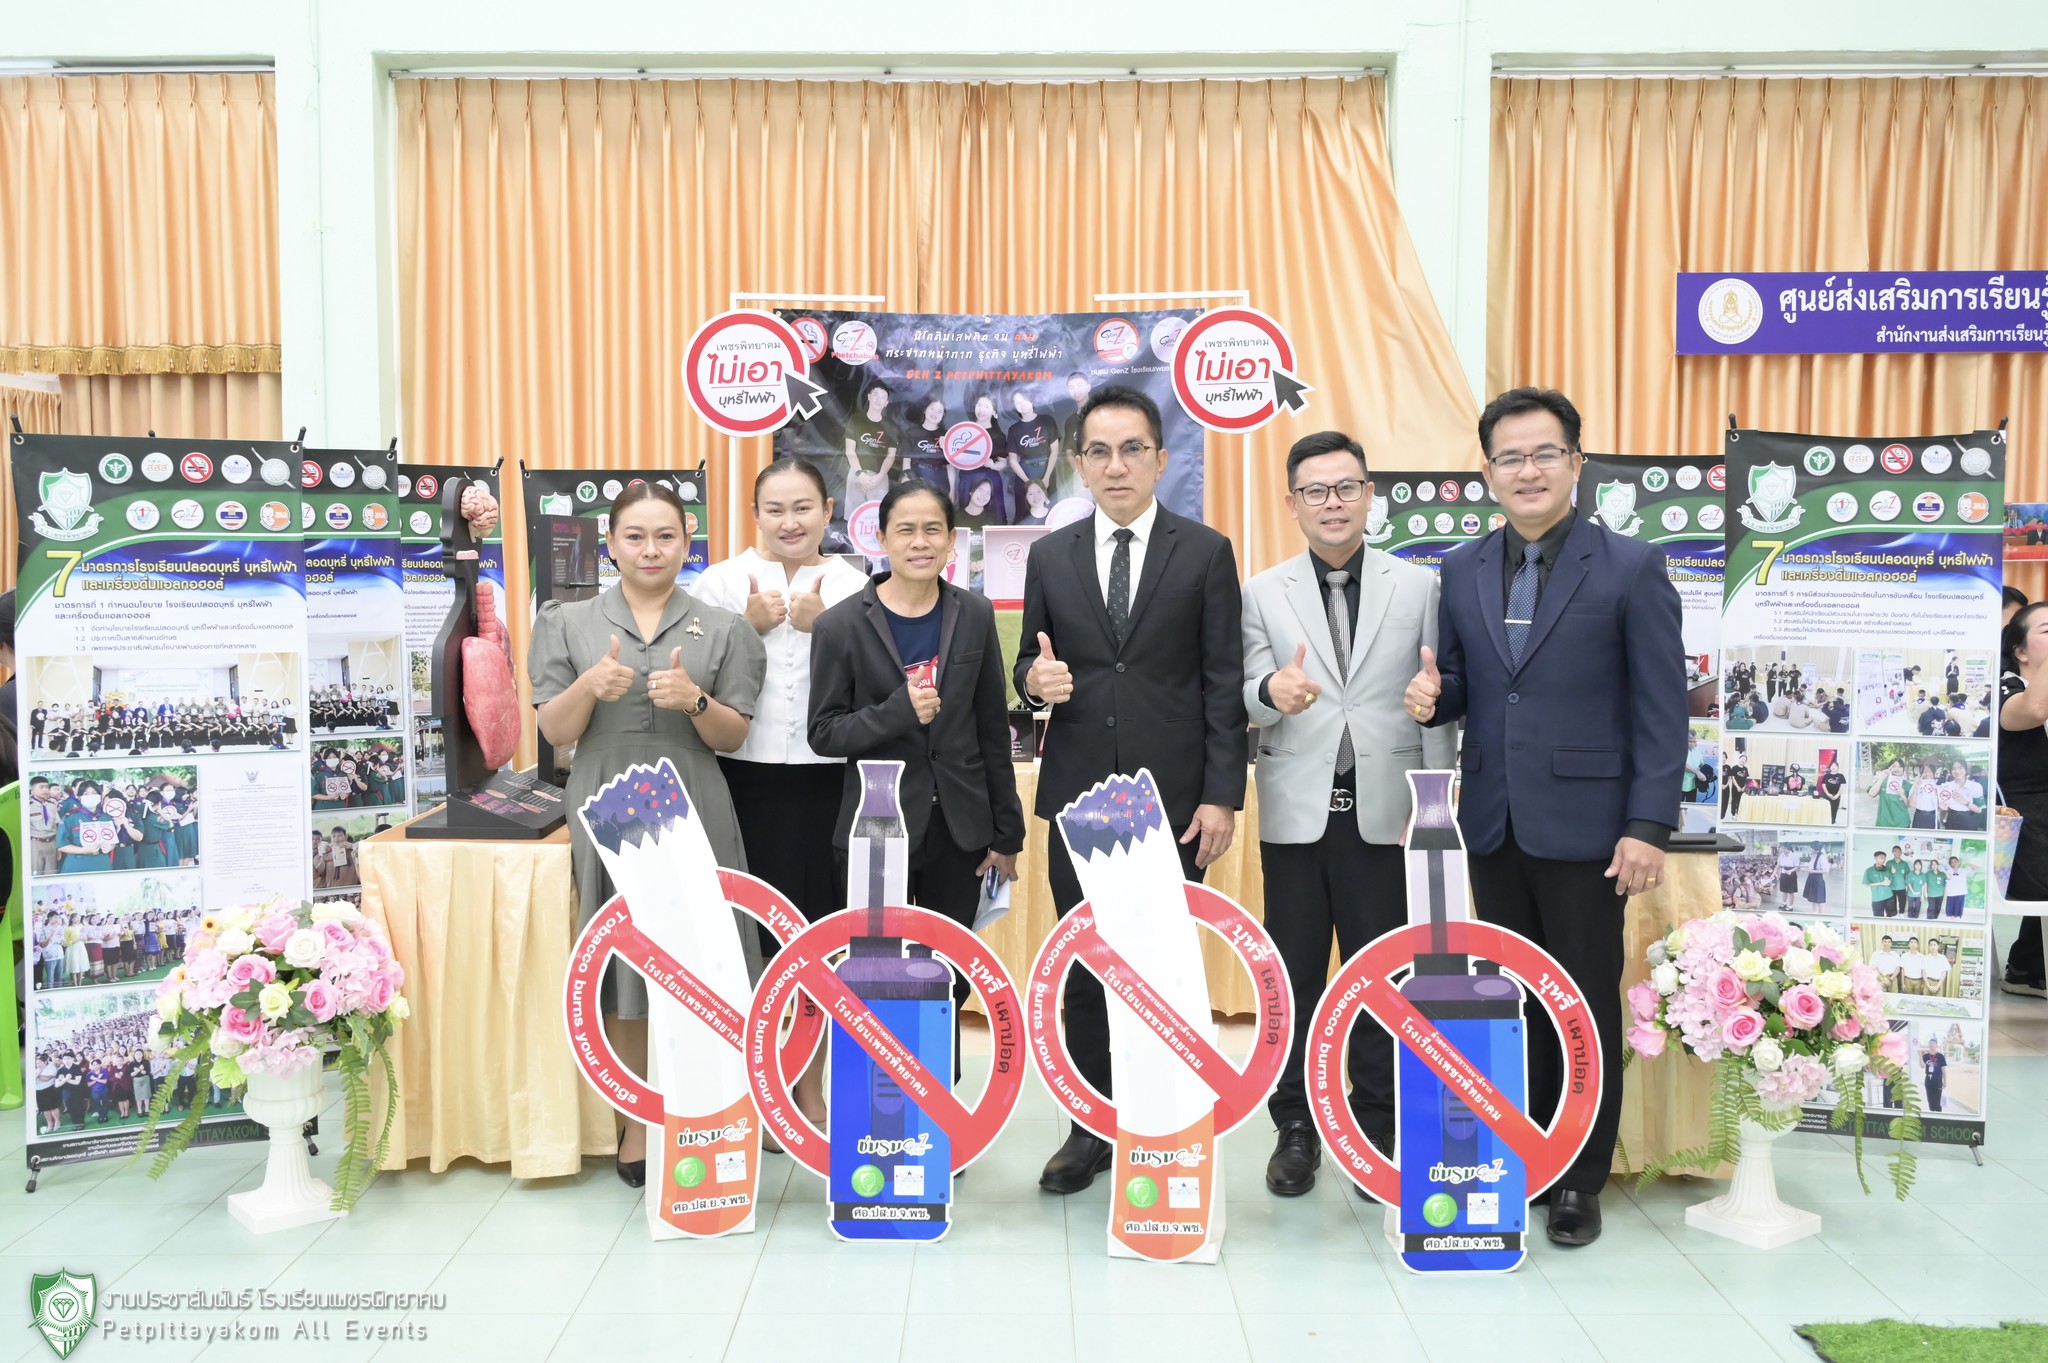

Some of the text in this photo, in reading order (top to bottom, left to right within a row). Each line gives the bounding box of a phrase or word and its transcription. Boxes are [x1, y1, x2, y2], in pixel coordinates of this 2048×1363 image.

[1779, 275, 2047, 323] ศูนย์ส่งเสริมการเรียน
[716, 340, 781, 351] เพชรพิทยาคม
[1204, 337, 1270, 348] เพชรพิทยาคม
[831, 351, 880, 360] Phetchabun
[885, 345, 1063, 363] กระชากหน้ากาก ธุรกิจ บุหรี่ไฟฟ้า
[707, 353, 783, 384] ไม่เอา
[906, 369, 930, 379] GEN
[934, 370, 943, 380] Z
[1110, 367, 1129, 375] GenZ
[1195, 350, 1271, 381] ไม่เอา
[718, 389, 776, 409] บุหรี่ไฟฟ้า
[1205, 387, 1263, 405] บุหรี่ไฟฟ้า
[81, 557, 298, 578] มาตรการโรงเรียนปลอดบุหรี่ บุหรี่ไฟฟ้า
[306, 554, 395, 570] ลอดบุหรี่ บุหรี่ไฟฟ้า
[1666, 555, 1725, 568] โรงเรียนปลอ
[1750, 540, 1785, 586] 7
[1781, 550, 1993, 569] มาตรการโรงเรียนปลอดบุหรี่ บุหรี่ไฟฟ้า
[46, 550, 83, 598] 7
[1781, 568, 1918, 583] และเครื่องดื่มแอลกอฮอล์
[82, 577, 225, 592] และเครื่องดื่มแอลกอฮอล์
[54, 600, 97, 609] มาตรการที่
[107, 600, 163, 609] กำหนดนโยบาย
[165, 600, 234, 610] โรงเรียนปลอดบุหรี่
[237, 600, 272, 610] บุหรี่ไฟฟ้า
[1925, 593, 1984, 602] โรงเรียนปลอดบุหรี่
[55, 611, 151, 620] และเครื่องดื่มแอลกอฮอล์
[767, 905, 802, 939] บุหรี
[1231, 922, 1274, 962] บุหรี่
[969, 955, 1009, 995] บุหรี่
[1537, 972, 1581, 1012] บุหรี่
[573, 910, 639, 1106] Tobacco burns your lungs
[1033, 917, 1092, 1116] Tobacco burns your lungs
[1259, 968, 1285, 1046] เผาปอด
[1102, 965, 1203, 1070] โรงเรียนเพชรพิทยาคม
[834, 996, 929, 1098] โรงเรียนเพชรพิทยาคม
[994, 1000, 1016, 1075] เผาปอด
[753, 956, 810, 1146] Tobacco burns your lungs
[1567, 1018, 1590, 1095] เผาปอด
[1317, 975, 1372, 1175] Tobacco burns your lungs
[1399, 1015, 1502, 1122] โรงเรียนเพชรพิทยาคม
[674, 1195, 749, 1213] ศอ.ปส.ย.จ.พช.
[853, 1206, 930, 1221] ศอ.ปส.ย.จ.พช.
[1125, 1221, 1203, 1234] ศอ.ปส.ย.จ.พช.
[1424, 1237, 1504, 1250] ศอ.ปส.ย.จ.พช.
